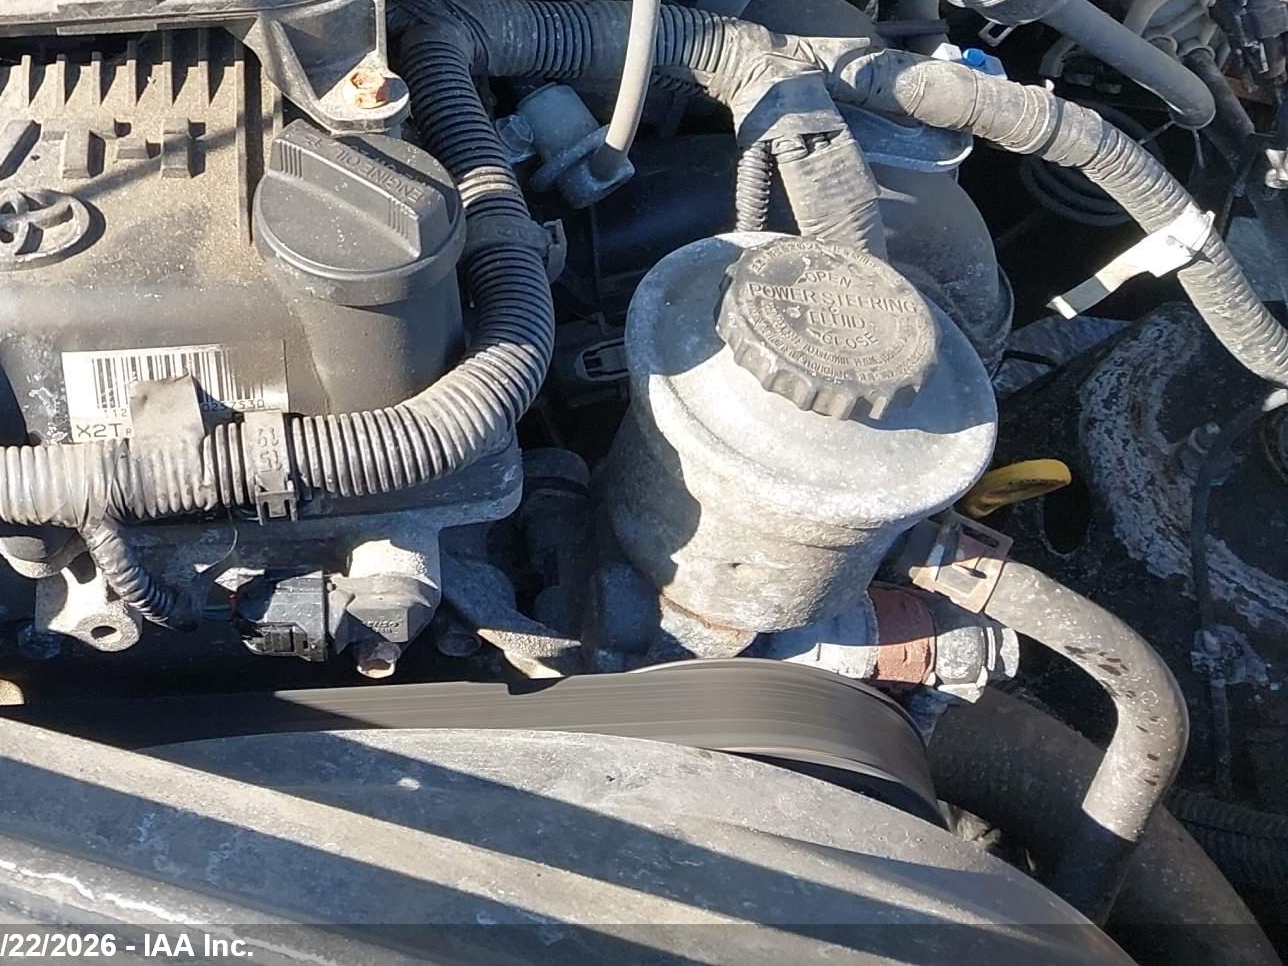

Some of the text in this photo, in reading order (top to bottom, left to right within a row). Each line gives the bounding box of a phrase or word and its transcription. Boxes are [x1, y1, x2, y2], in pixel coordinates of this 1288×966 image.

[336, 146, 425, 203] ENGINE OIL
[749, 283, 917, 314] POWER STEERING
[76, 423, 122, 438] X2T
